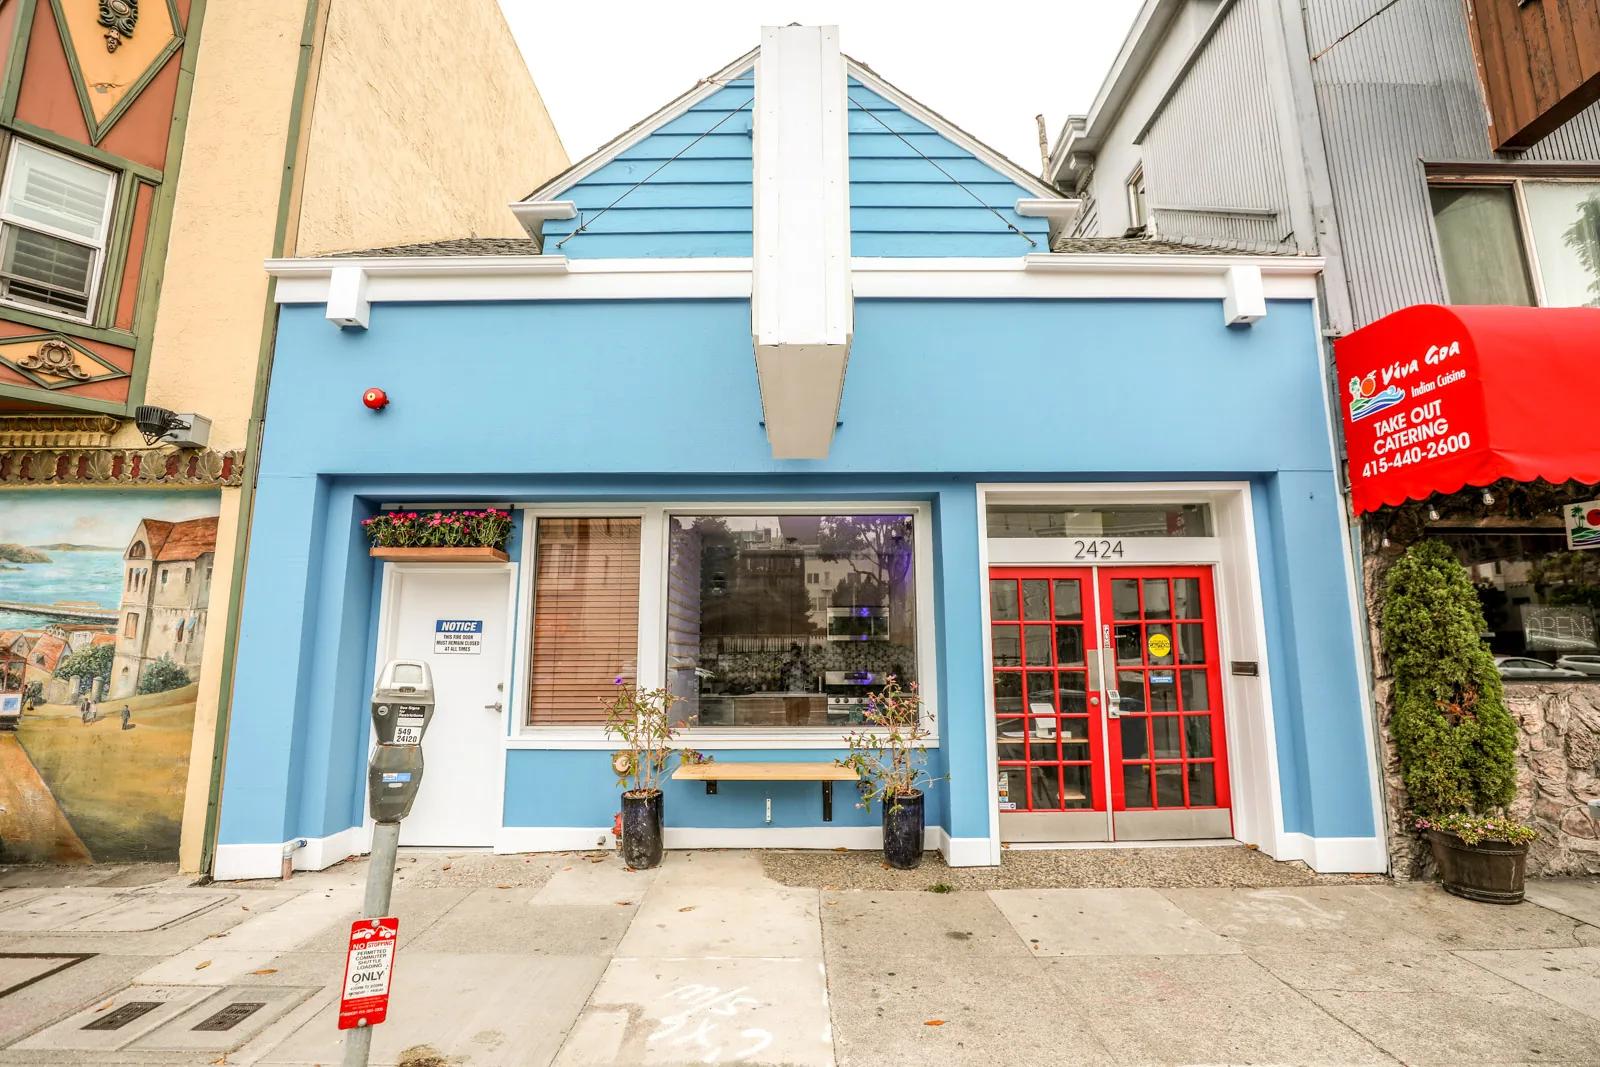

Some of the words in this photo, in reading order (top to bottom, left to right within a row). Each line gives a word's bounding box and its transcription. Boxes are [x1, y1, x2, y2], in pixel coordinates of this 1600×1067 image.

[1381, 360, 1419, 386] Viva
[1424, 341, 1460, 365] Goa
[1411, 381, 1436, 398] Indian
[1437, 368, 1466, 388] Cuisine
[1374, 413, 1407, 438] TAKE
[1410, 399, 1442, 424] OUT
[1374, 418, 1448, 455] CATERING
[1362, 432, 1471, 478] 415-440-2600
[1074, 540, 1124, 558] 2424
[441, 621, 477, 631] NOTICE
[1527, 616, 1587, 640] OPEN
[396, 735, 417, 743] 24120
[356, 948, 387, 956] PERMITTED
[367, 940, 393, 949] STOPPING
[355, 953, 387, 961] COMMUTER
[356, 963, 383, 971] LOADING
[351, 970, 385, 983] ONLY
